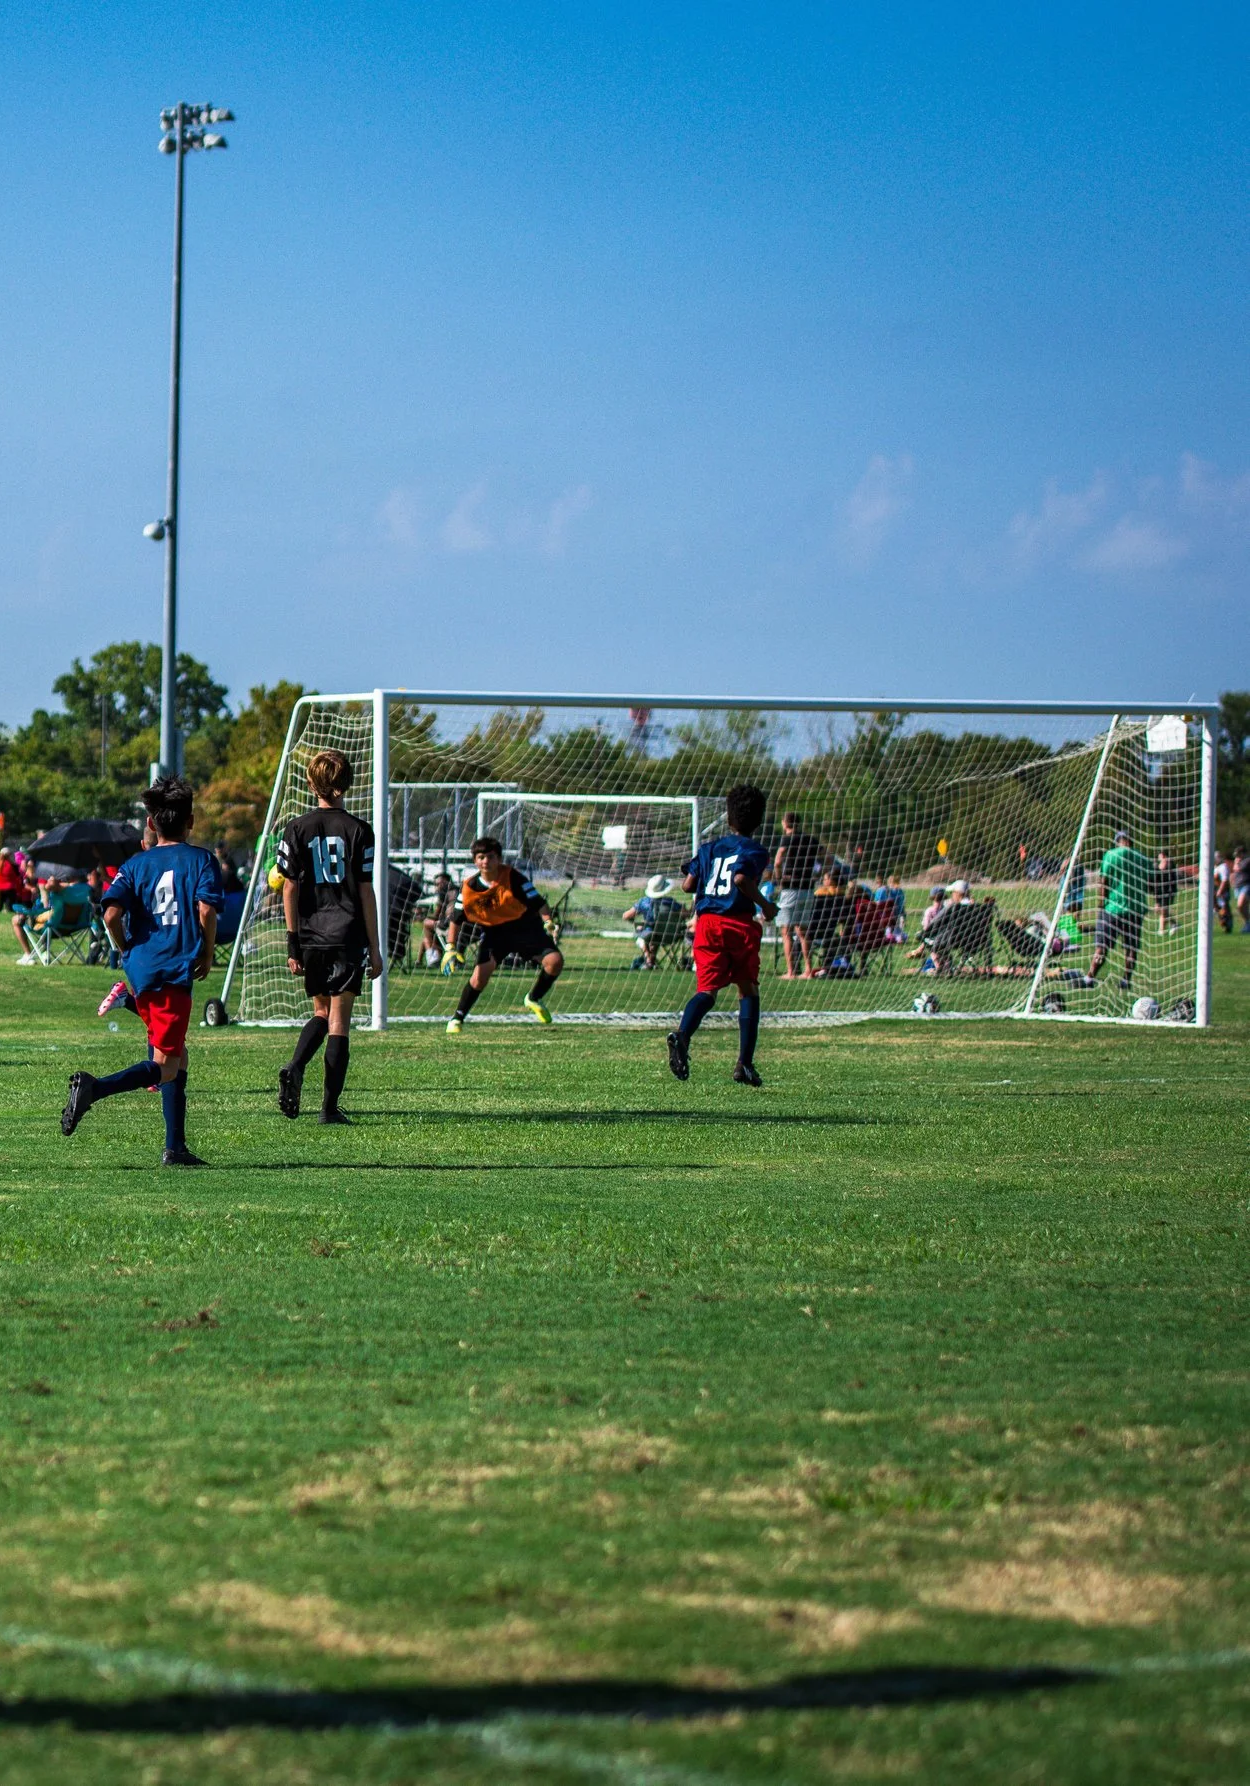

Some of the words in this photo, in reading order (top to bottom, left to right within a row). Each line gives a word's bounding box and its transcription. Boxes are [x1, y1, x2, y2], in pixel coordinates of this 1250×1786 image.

[308, 836, 345, 884] 18
[705, 855, 738, 896] 15
[152, 869, 178, 926] 4
